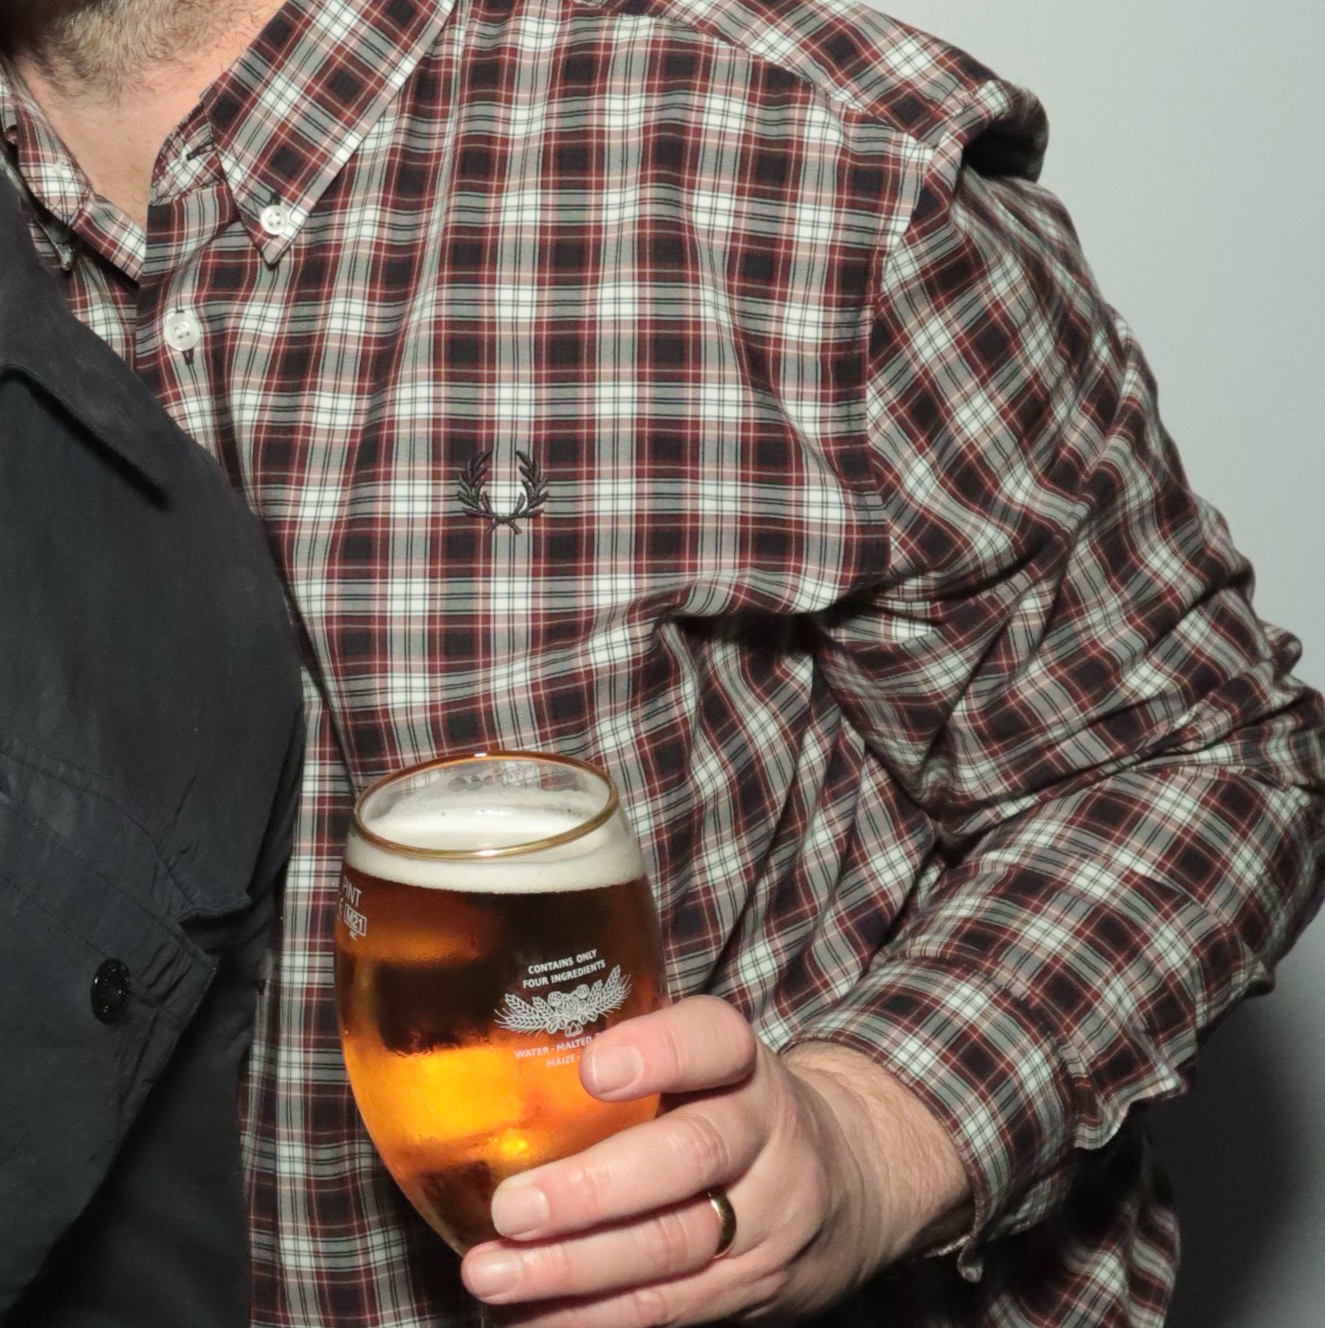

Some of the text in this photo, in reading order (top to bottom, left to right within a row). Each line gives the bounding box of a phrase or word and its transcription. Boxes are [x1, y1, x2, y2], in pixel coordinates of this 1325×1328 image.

[522, 959, 606, 989] FOUR INGREDIENTS
[527, 948, 598, 975] CONTAINS ONLY
[515, 1046, 550, 1059] WATER
[556, 1035, 593, 1052] MALTED
[546, 1053, 576, 1068] MAIZE
